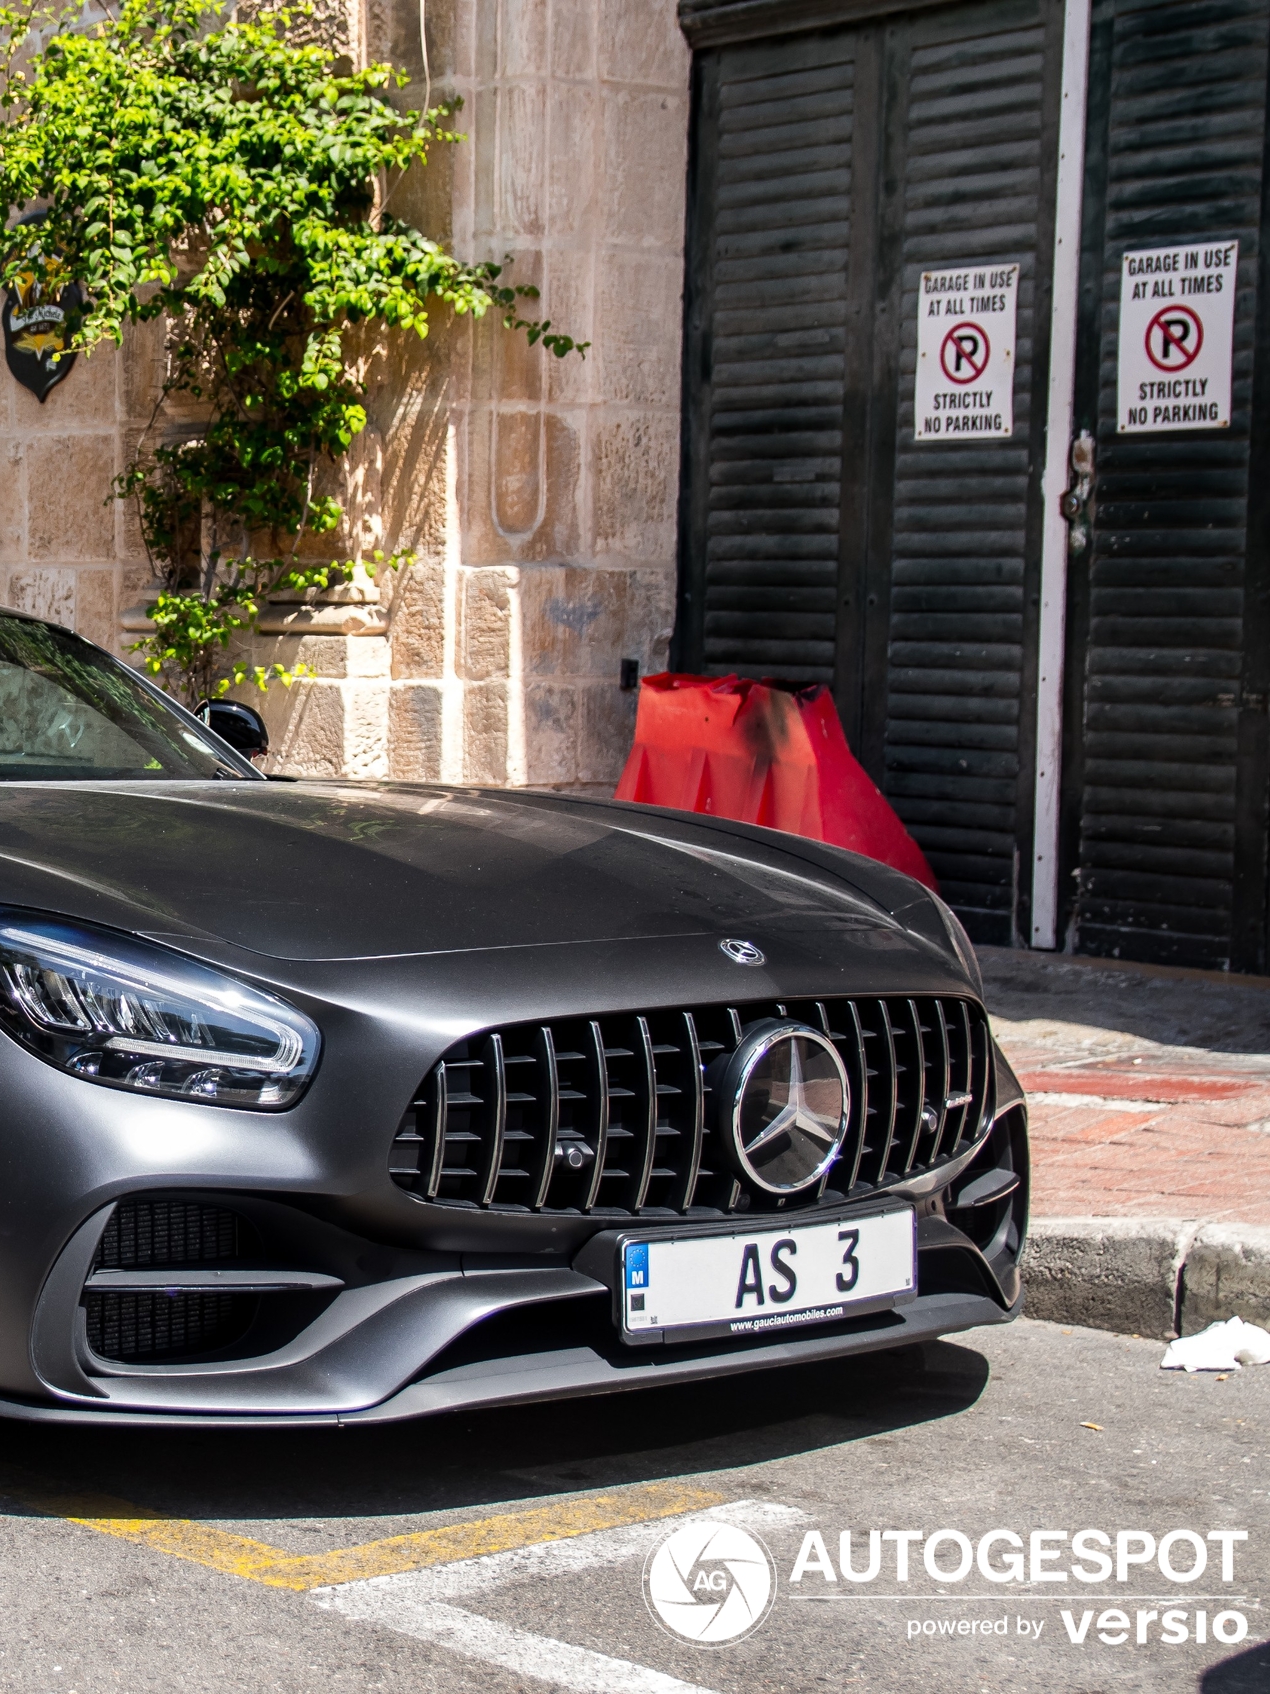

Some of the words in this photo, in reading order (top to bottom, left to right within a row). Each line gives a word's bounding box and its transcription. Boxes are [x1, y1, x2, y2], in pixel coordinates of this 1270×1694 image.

[1129, 252, 1179, 277] GARAGE
[1184, 250, 1199, 271] IN
[1204, 247, 1231, 269] USE
[925, 274, 970, 295] GARAGE
[974, 272, 986, 290] IN
[990, 269, 1013, 288] USE
[1132, 280, 1150, 300] AT
[1152, 278, 1175, 298] ALL
[1180, 274, 1223, 295] TIMES
[928, 298, 944, 317] AT
[946, 296, 965, 316] ALL
[970, 294, 1006, 313] TIMES
[933, 390, 993, 411] STRICTLY
[1139, 378, 1209, 401] STRICTLY
[925, 416, 941, 433] NO
[946, 413, 1002, 432] PARKING
[1129, 407, 1147, 425] NO
[1153, 402, 1219, 423] PARKING
[632, 1270, 644, 1285] M
[734, 1238, 798, 1309] AS
[835, 1228, 860, 1292] 3
[730, 1306, 844, 1331] www.gauciautomobiles.com
